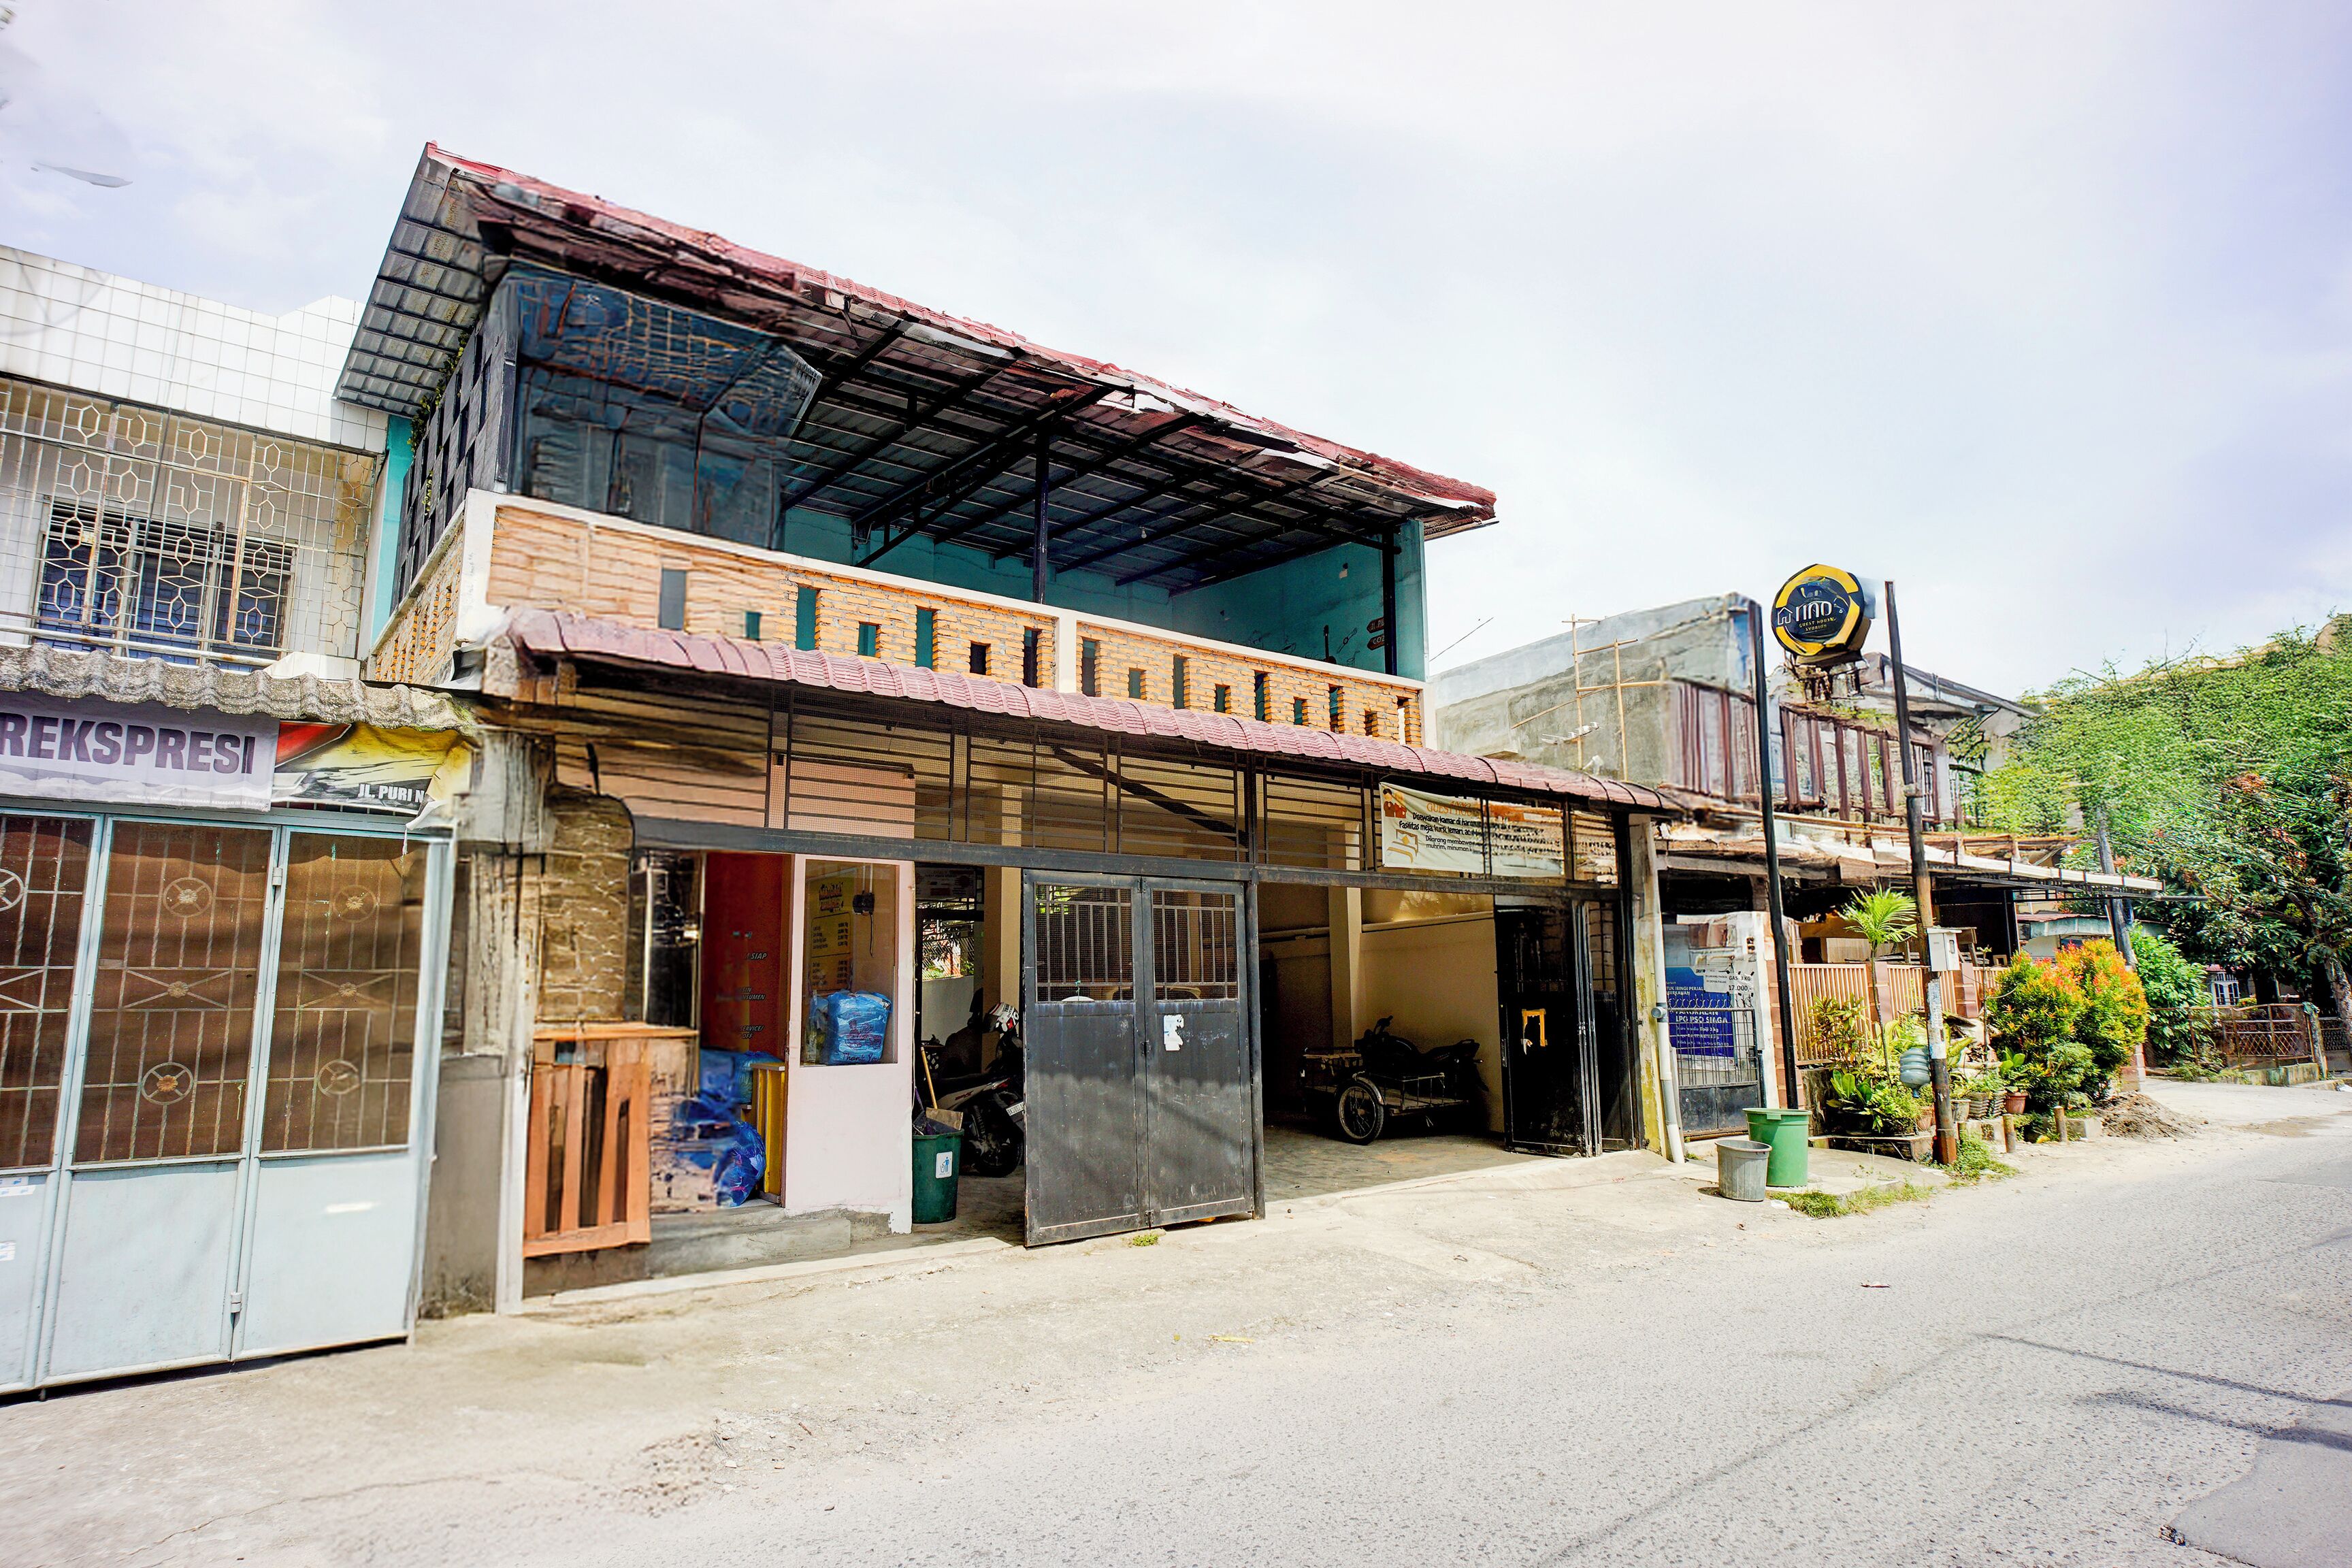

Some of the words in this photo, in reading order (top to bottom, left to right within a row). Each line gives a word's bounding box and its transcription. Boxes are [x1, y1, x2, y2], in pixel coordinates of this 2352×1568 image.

[0, 712, 256, 774] REKSPRESI
[357, 783, 376, 798] JL.
[378, 785, 412, 802] PURI
[1426, 802, 1453, 815] GUEST
[1413, 813, 1439, 823] Disewakan
[1439, 816, 1456, 824] kamar
[1399, 821, 1420, 830] Fasilitas
[1426, 835, 1447, 845] Dilarang
